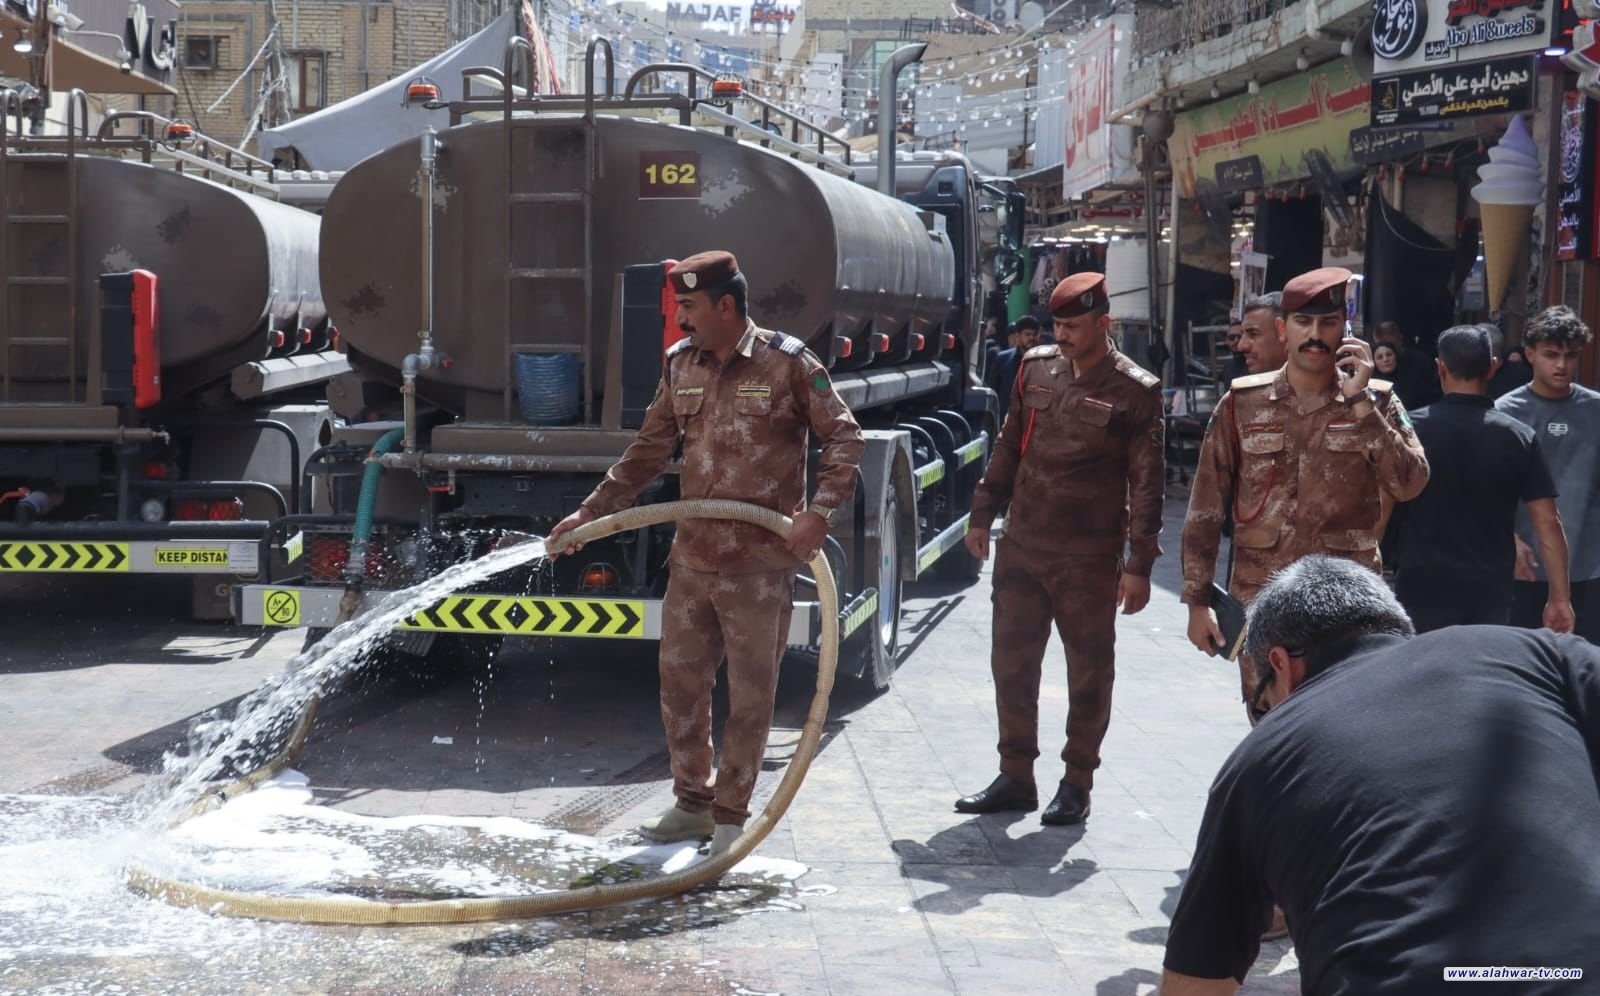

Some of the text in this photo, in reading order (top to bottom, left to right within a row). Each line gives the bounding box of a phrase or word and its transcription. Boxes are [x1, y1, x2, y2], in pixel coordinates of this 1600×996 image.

[667, 2, 742, 23] NAJAF
[1446, 15, 1536, 47] Abo Ali Sweets
[1402, 65, 1529, 106] دهين أبو علي الأصلي
[645, 164, 696, 184] 162
[158, 552, 188, 562] KEEP
